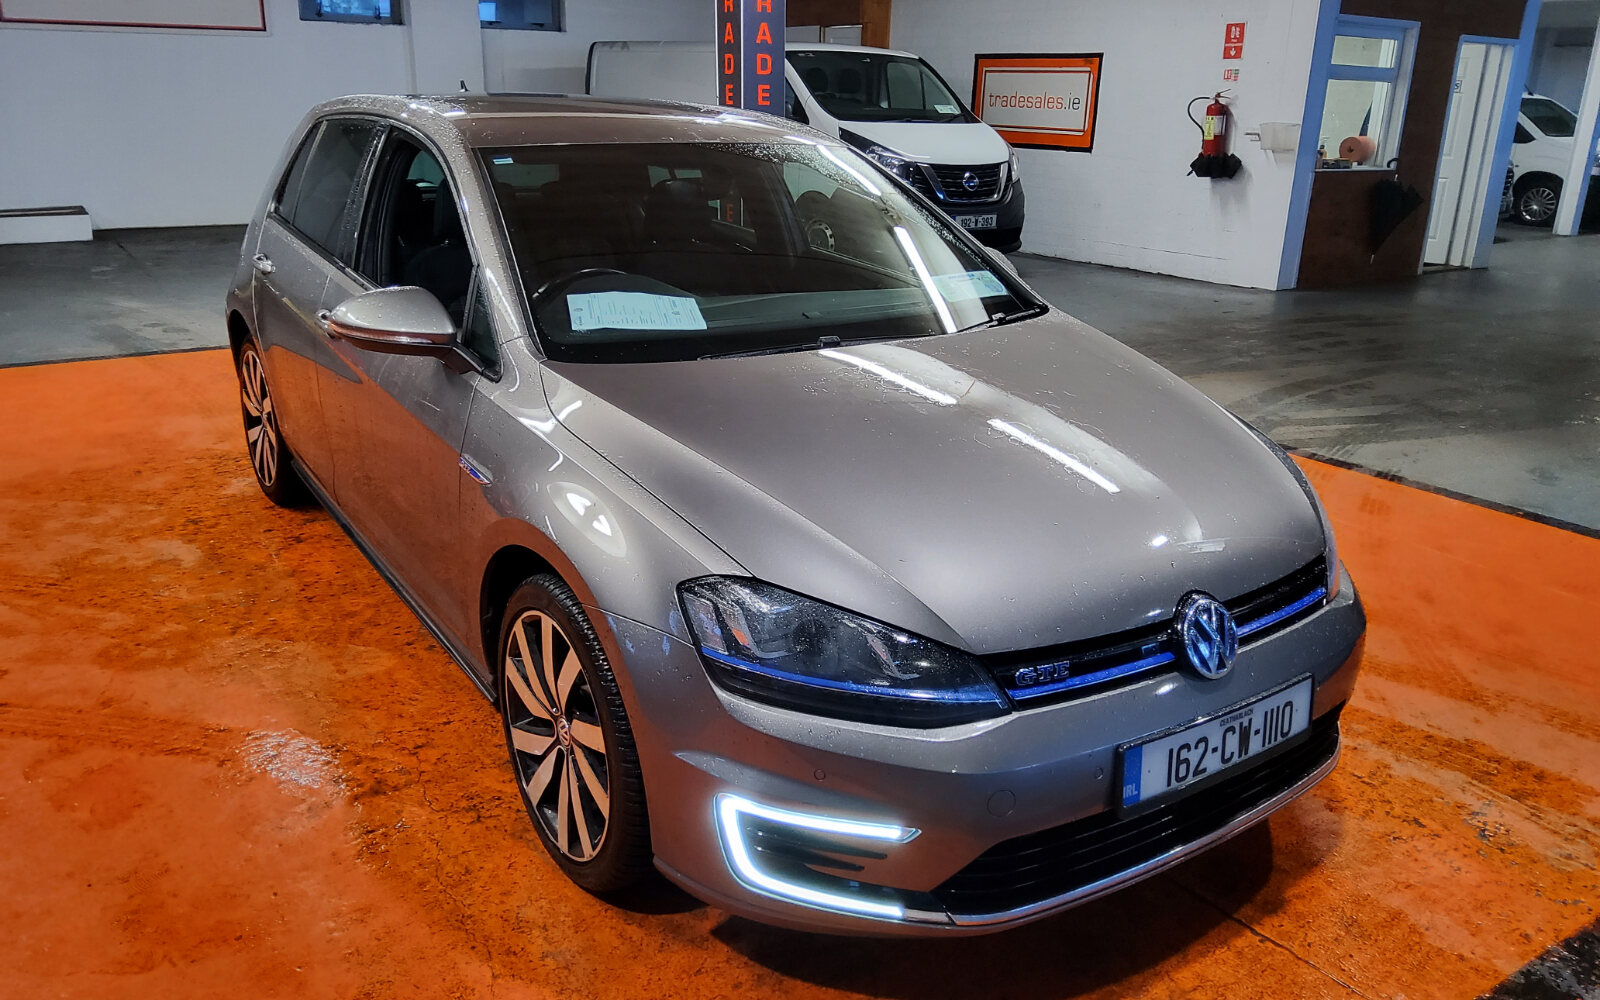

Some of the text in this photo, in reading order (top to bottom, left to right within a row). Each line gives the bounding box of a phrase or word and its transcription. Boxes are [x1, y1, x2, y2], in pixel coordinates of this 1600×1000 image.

[989, 91, 1081, 110] tradesales.ie
[1015, 660, 1070, 686] GTE
[1166, 700, 1294, 788] 162-CW-1110
[1123, 783, 1139, 799] IRL
